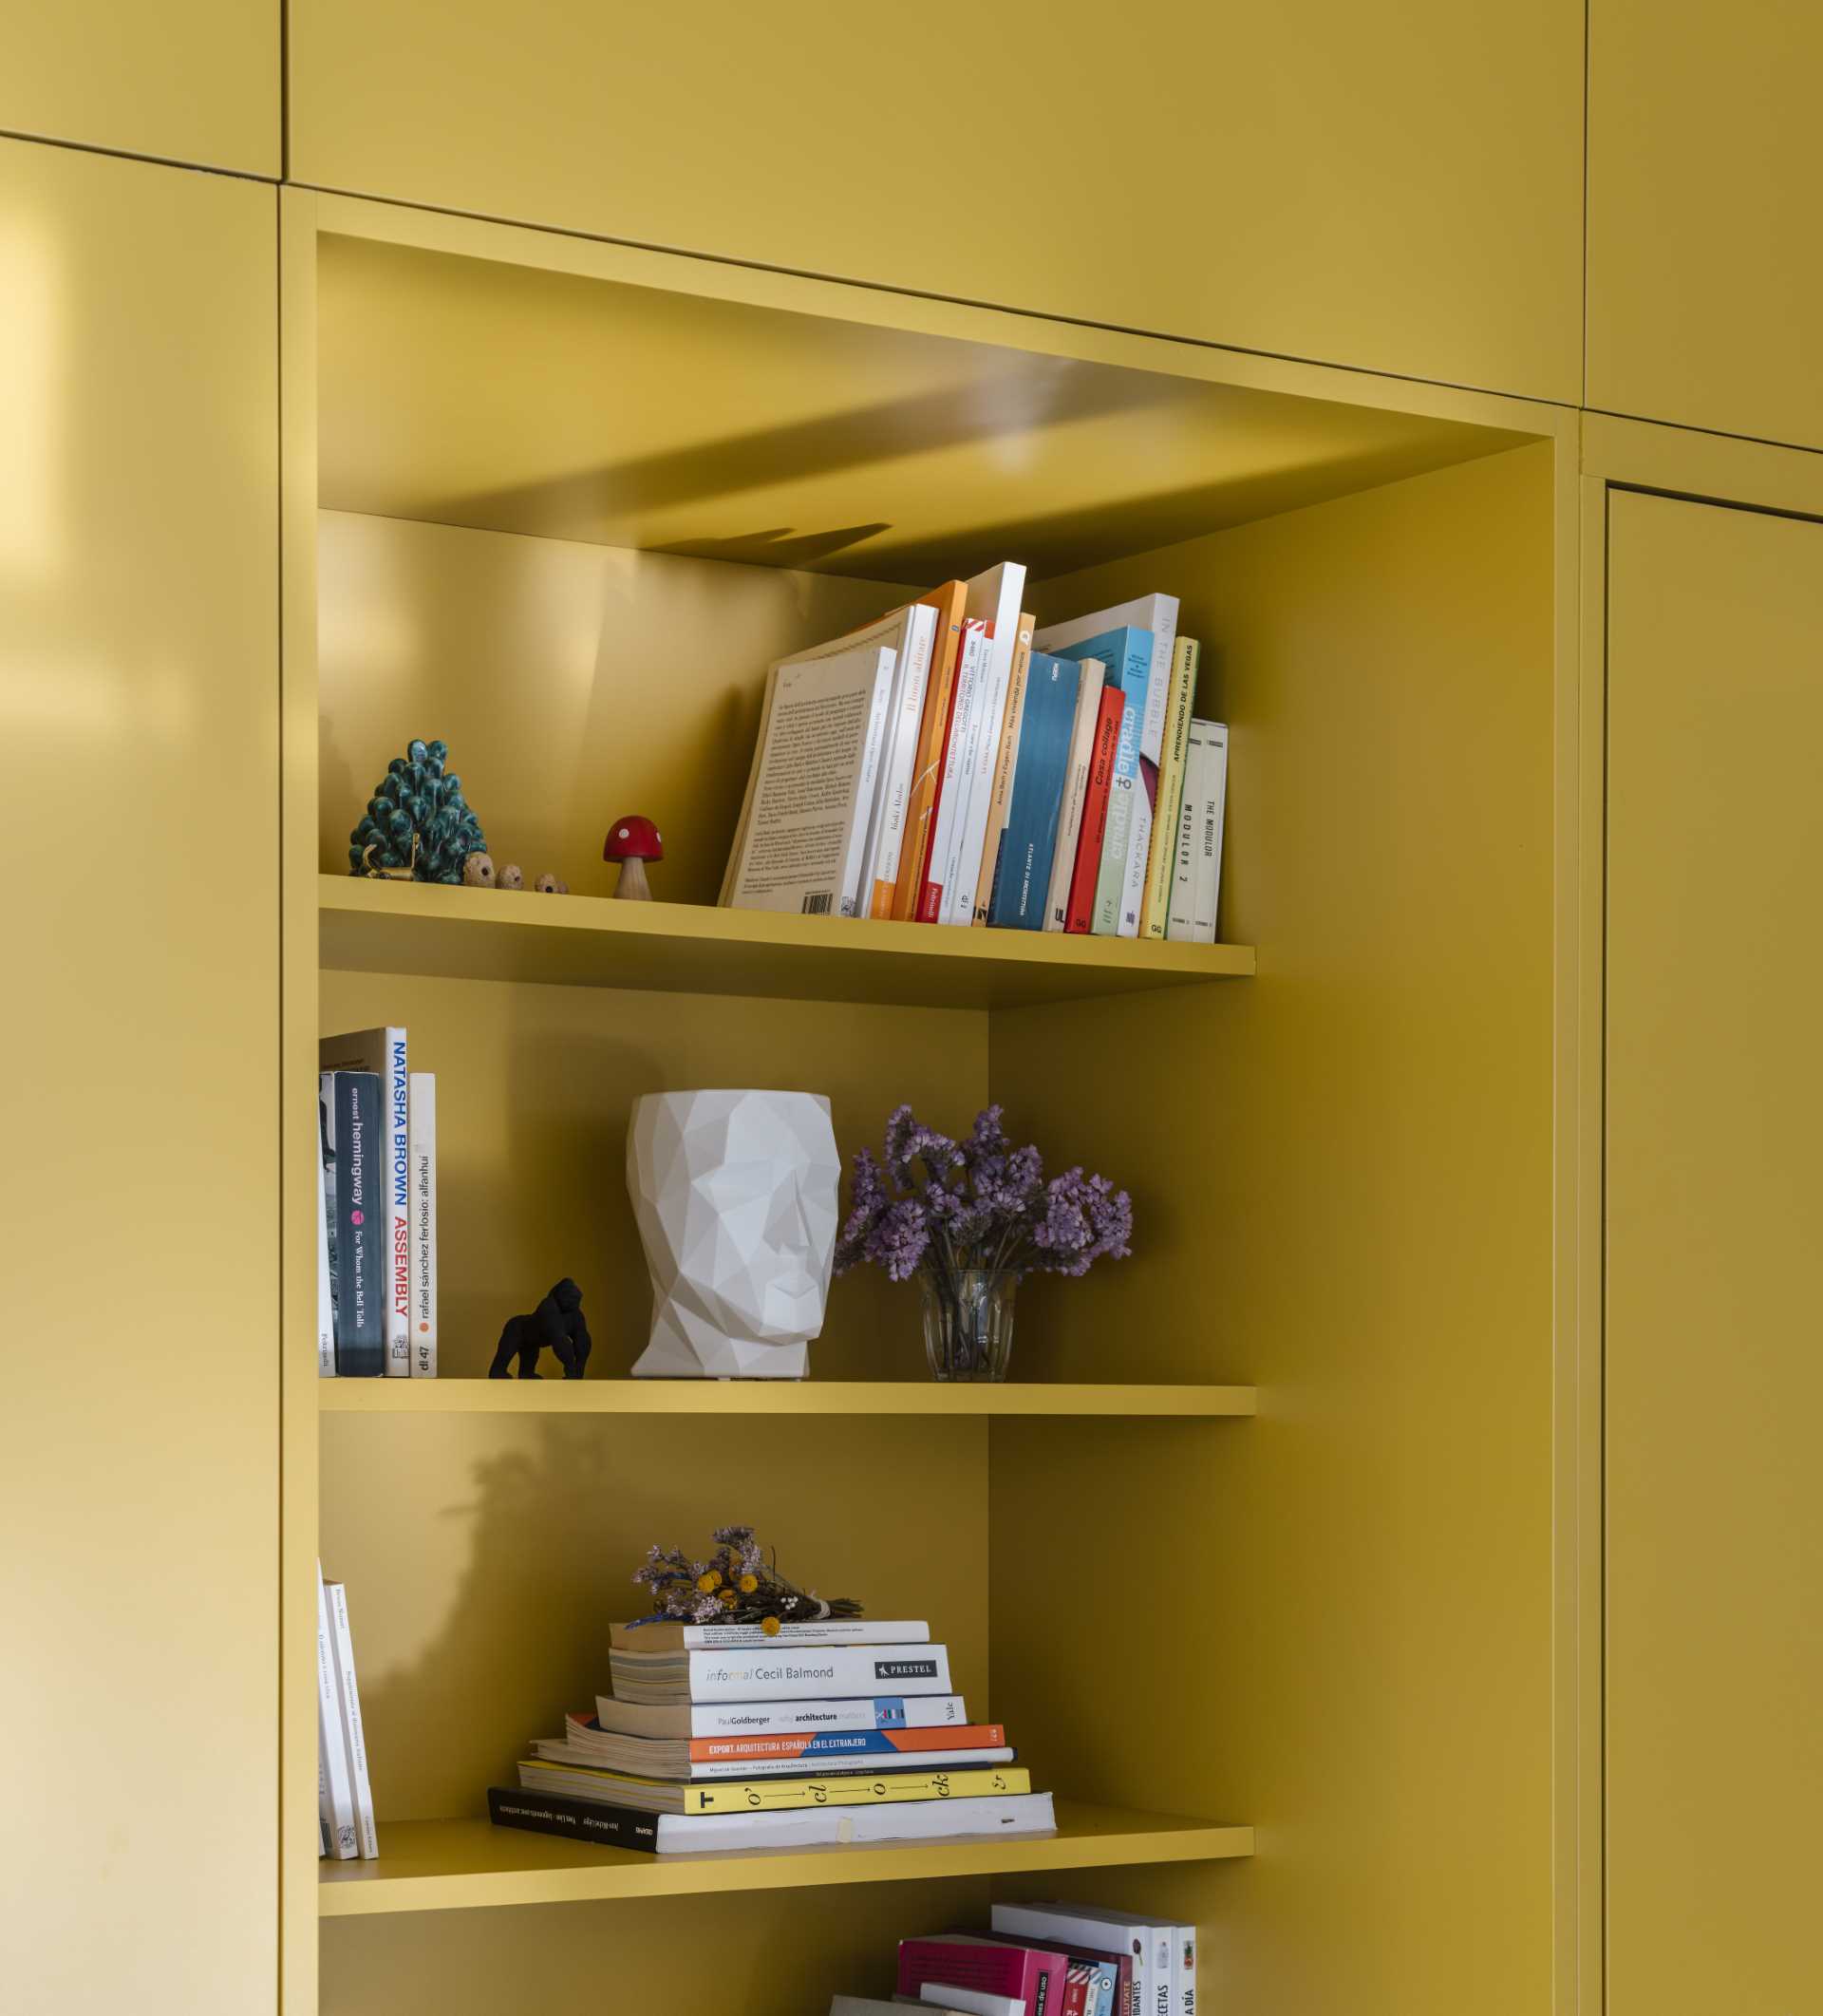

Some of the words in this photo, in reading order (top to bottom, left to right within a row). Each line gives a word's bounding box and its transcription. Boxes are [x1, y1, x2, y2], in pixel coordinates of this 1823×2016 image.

[1159, 616, 1171, 632] IN
[1156, 641, 1168, 669] THE
[956, 670, 968, 710] TERRITORIO
[965, 666, 975, 698] VITTORIO
[1009, 687, 1020, 714] vivienda
[1147, 676, 1163, 738] BUBBLE
[1173, 704, 1185, 763] APRENDIENDO
[1179, 690, 1187, 703] DE
[1183, 644, 1193, 671] VEGAS
[960, 698, 969, 732] GREGOTTI
[1099, 717, 1112, 756] collage
[1116, 707, 1140, 776] cradle
[1094, 758, 1105, 785] Casa
[1205, 800, 1214, 815] THE
[1179, 802, 1193, 865] MODULOR
[1203, 819, 1213, 857] MODULOR
[1025, 842, 1034, 870] ATLANTE
[1130, 816, 1146, 888] THACKARA
[927, 887, 937, 918] Feltrinelli
[1019, 879, 1029, 915] ARCHITETTURA
[1151, 924, 1162, 933] GG
[391, 1042, 407, 1127] NATASHA
[349, 1121, 365, 1206] hemingway
[392, 1134, 407, 1206] BROWN
[418, 1156, 428, 1196] alfanhuí
[419, 1198, 429, 1239] ferlosio:
[354, 1230, 363, 1245] For
[392, 1215, 409, 1317] ASSEMBLY
[419, 1244, 429, 1286] sánchez
[355, 1275, 364, 1289] the
[356, 1308, 365, 1328] Tolls
[419, 1290, 429, 1318] rafael
[419, 1345, 428, 1358] 47
[706, 1667, 753, 1681] informal
[755, 1667, 782, 1680] Cecil
[786, 1667, 834, 1680] Balmond
[890, 1665, 932, 1675] PRESTEL
[795, 1713, 837, 1723] architecture
[945, 1702, 955, 1721] Yale
[736, 1742, 780, 1754] ARQUITECTURA
[781, 1739, 812, 1751] ESPAÑOLA
[813, 1740, 821, 1749] EN
[821, 1739, 828, 1749] EL
[829, 1737, 867, 1748] EXTRANJERO
[700, 1792, 714, 1808] T
[873, 1782, 887, 1796] o
[931, 1774, 949, 1798] ck
[1038, 1990, 1044, 2001] de
[1181, 1989, 1193, 2006] DÍA
